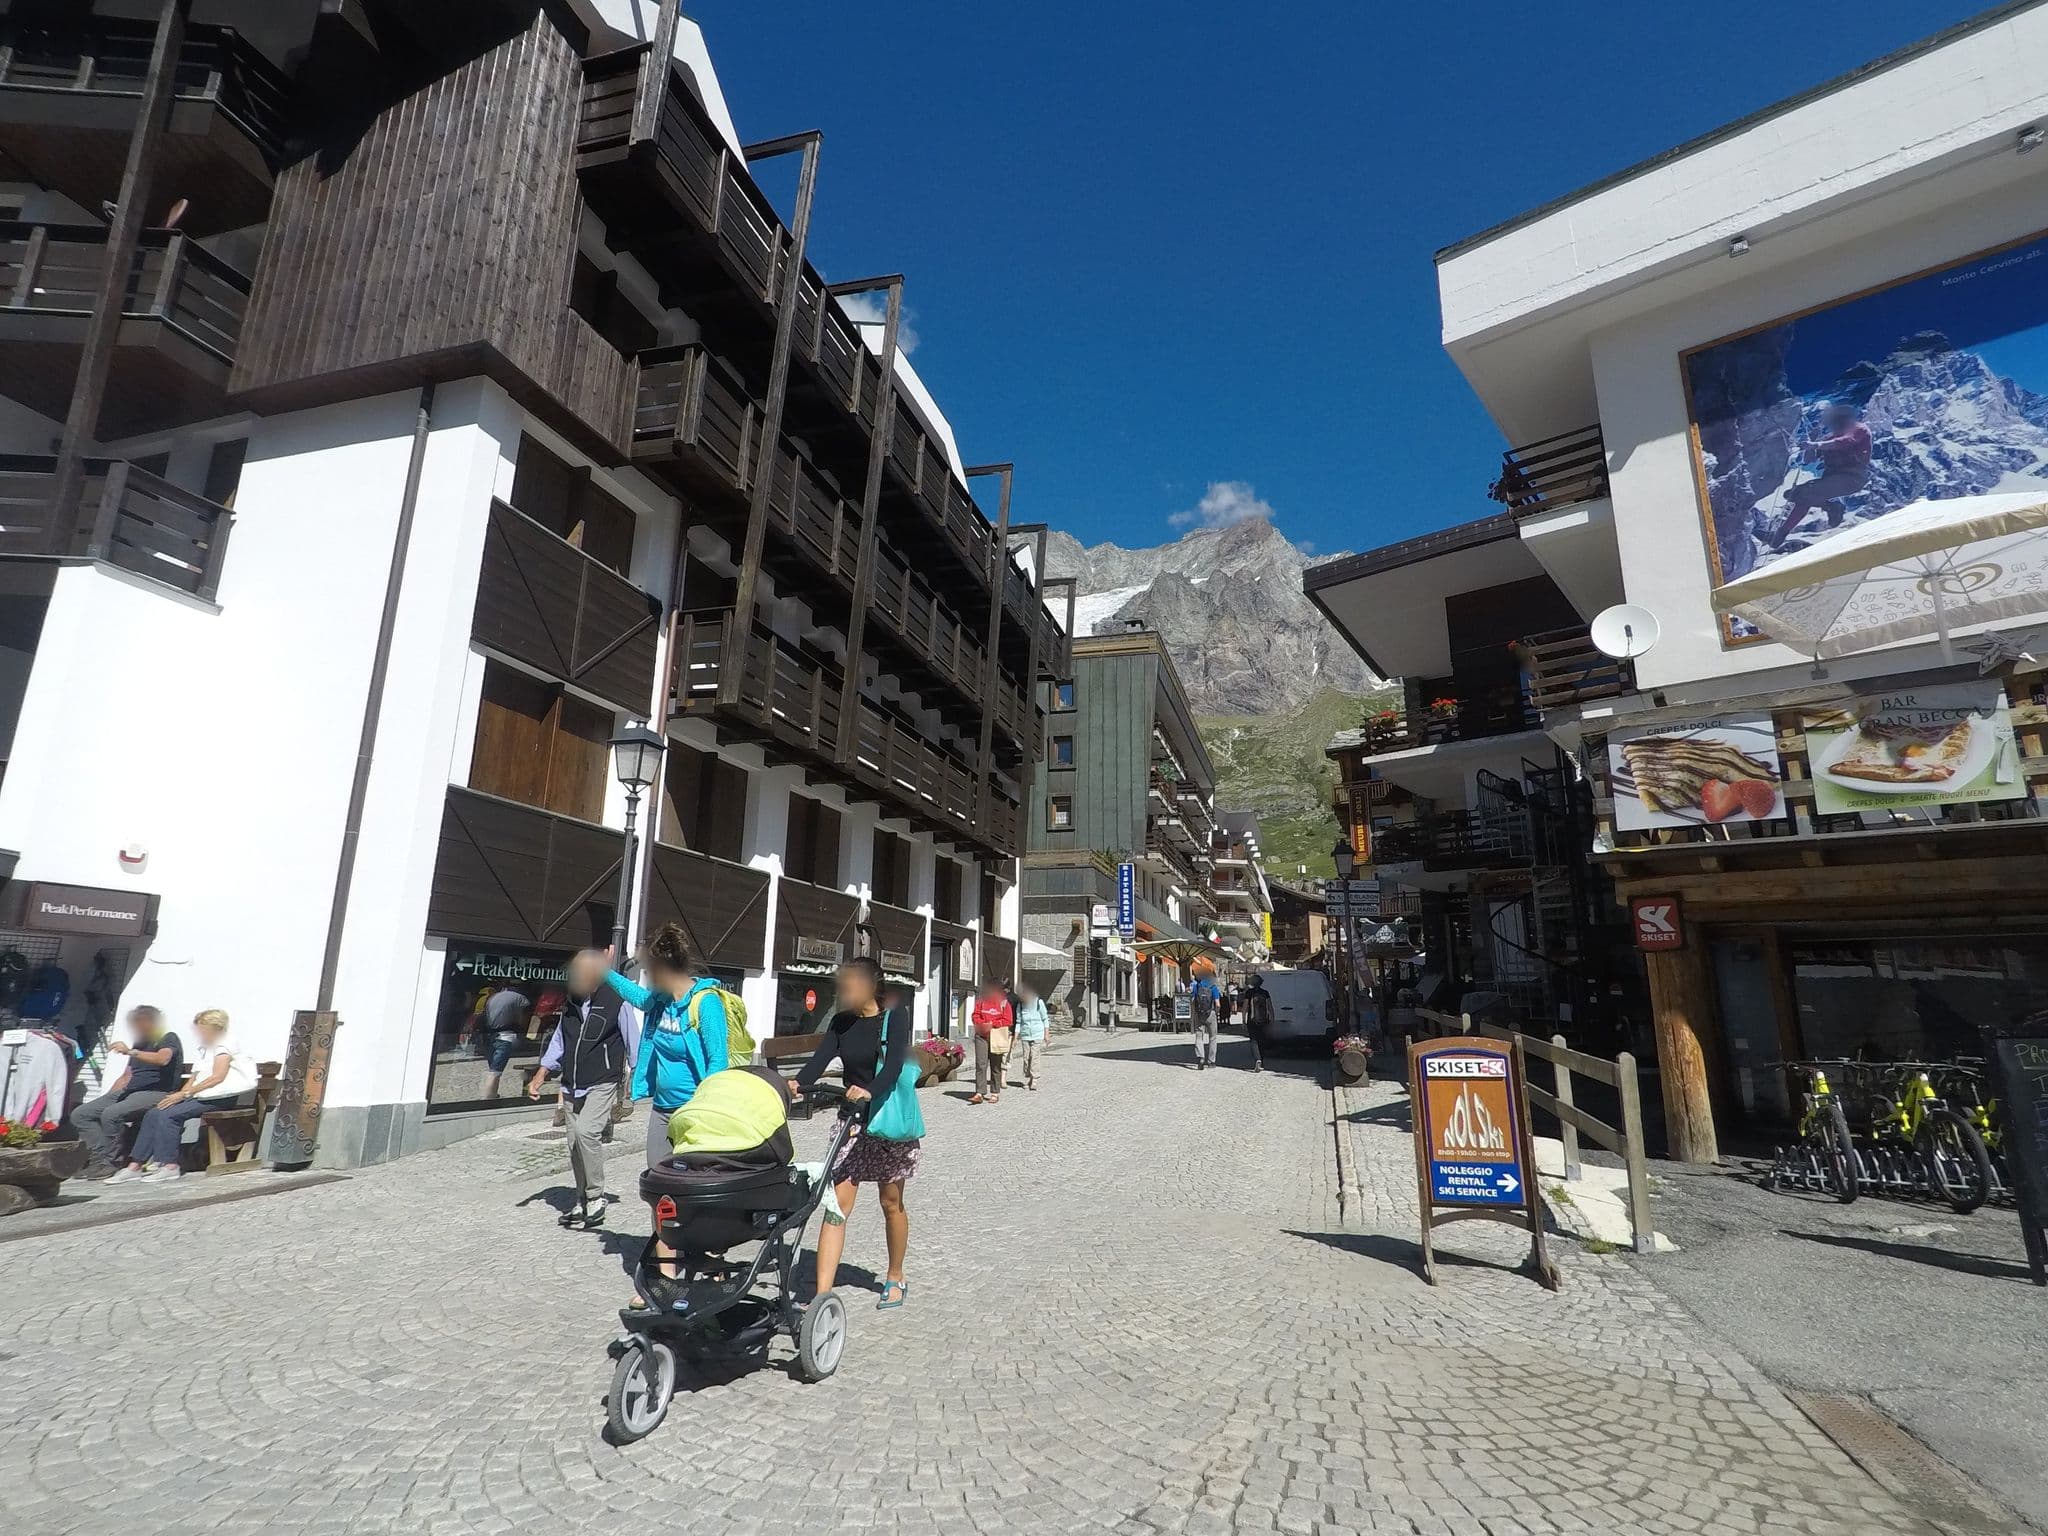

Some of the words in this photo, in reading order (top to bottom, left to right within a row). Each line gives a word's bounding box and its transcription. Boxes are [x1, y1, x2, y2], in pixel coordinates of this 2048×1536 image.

[1941, 271, 1977, 287] Monte
[1980, 255, 2024, 275] Cervino
[1881, 694, 1918, 711] BAR
[1919, 705, 1986, 724] BECCA
[1646, 724, 1688, 737] CREPES
[1689, 719, 1722, 731] DOLCI
[1122, 865, 1130, 922] RISTORANTE
[1641, 933, 1676, 941] SKISET
[1427, 1061, 1483, 1073] SKISET
[1440, 1165, 1493, 1176] NOLEGGIO
[1448, 1176, 1487, 1187] RENTAL
[1439, 1186, 1455, 1196] SKI
[1457, 1187, 1498, 1198] SERVICE
